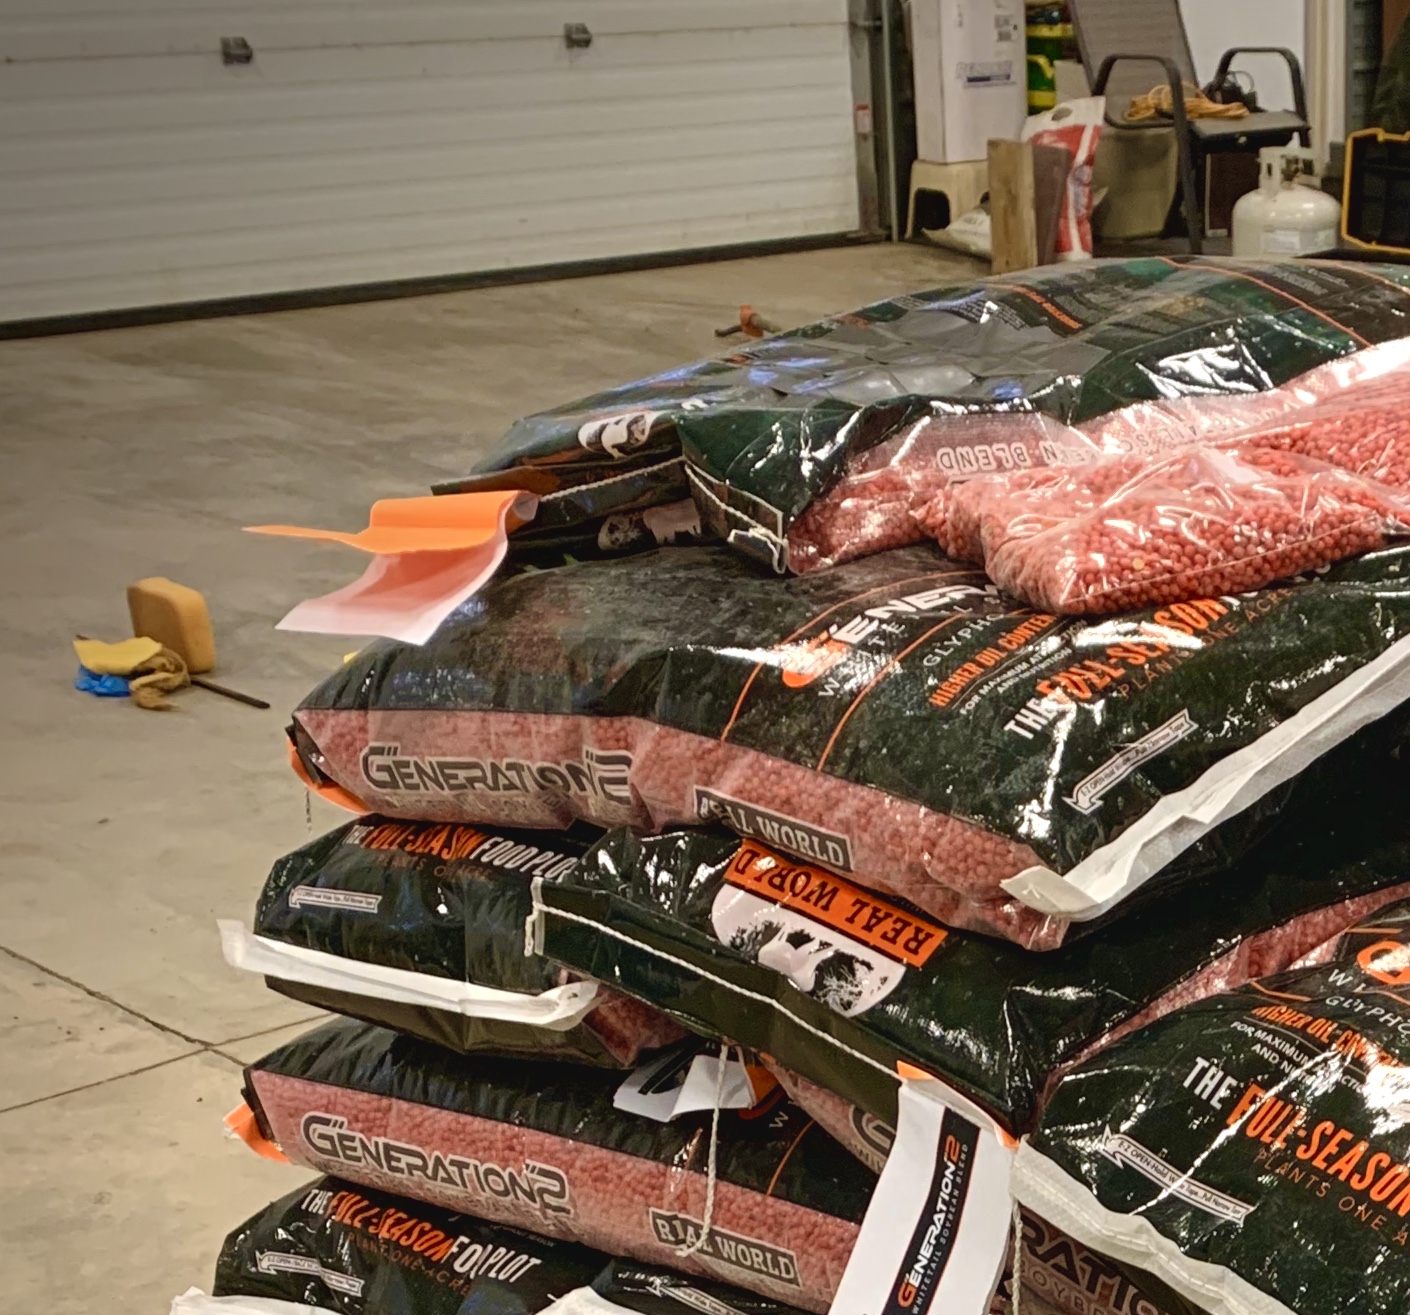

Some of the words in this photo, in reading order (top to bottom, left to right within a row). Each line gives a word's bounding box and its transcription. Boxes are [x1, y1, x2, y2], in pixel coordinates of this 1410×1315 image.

[936, 442, 1027, 476] BLEND
[1246, 587, 1294, 623] ACRE
[929, 665, 984, 707] HIGHER
[975, 645, 1008, 668] OIL
[959, 691, 983, 716] FOR
[977, 659, 1031, 698] MAXIMUM
[520, 846, 580, 880] PLO
[758, 814, 847, 867] WORLD
[734, 848, 841, 913] WORLD
[844, 897, 935, 956] REAL
[1230, 1020, 1253, 1038] FOR
[1251, 1005, 1312, 1029] HIGHER
[1305, 1016, 1336, 1045] OIL
[1250, 1042, 1281, 1066] AND
[1183, 1056, 1239, 1111] THE
[1254, 1148, 1331, 1198] PLANTS
[1338, 1195, 1388, 1231] ONE
[301, 1189, 334, 1214] THE
[480, 1246, 542, 1283] PLOT
[912, 1249, 943, 1315] WHITETAIL
[939, 1187, 961, 1245] SOYBEAN
[955, 1142, 969, 1186] BLEND
[714, 1234, 796, 1280] WORLD
